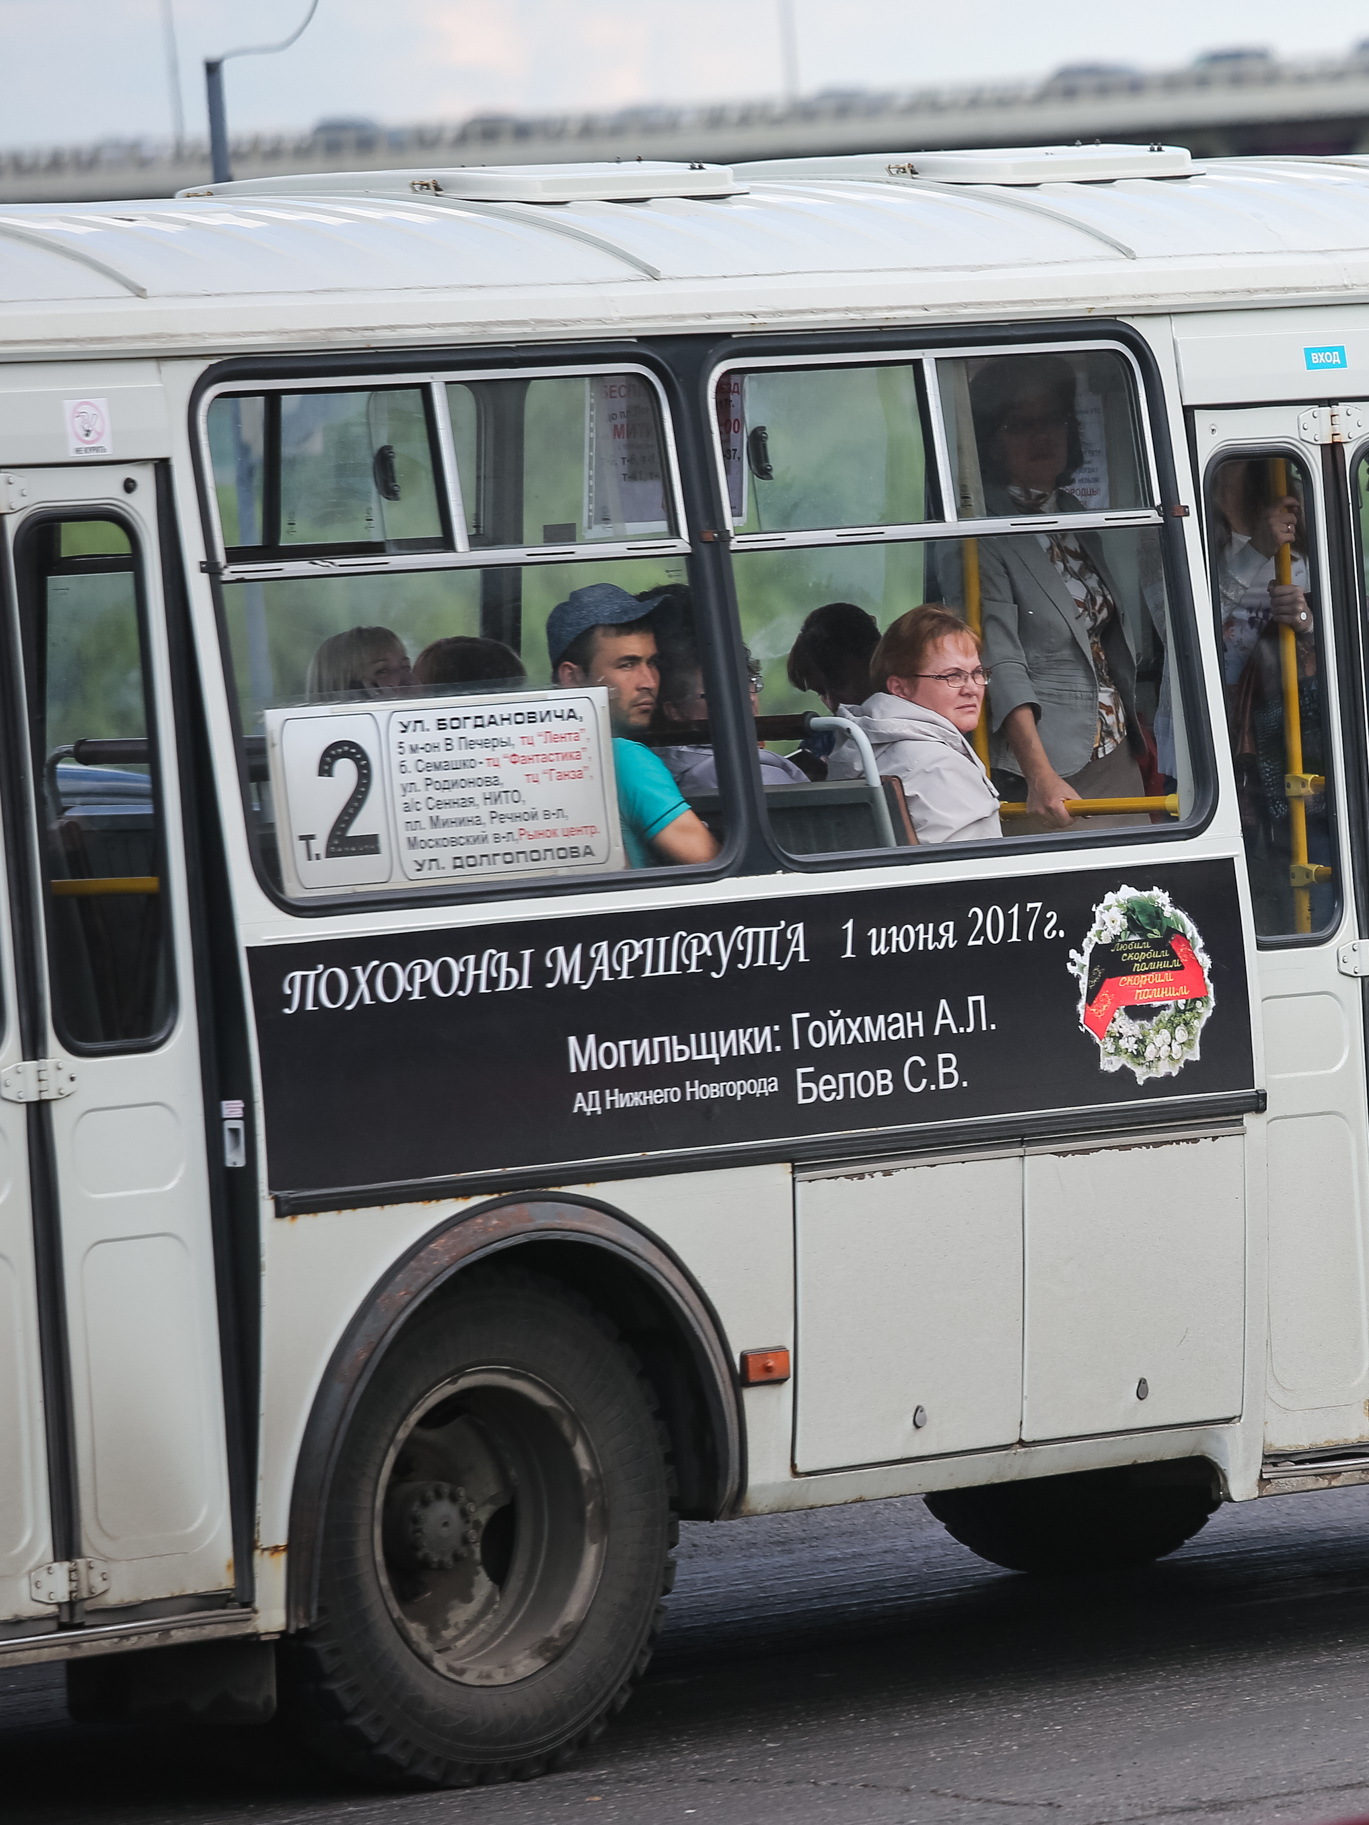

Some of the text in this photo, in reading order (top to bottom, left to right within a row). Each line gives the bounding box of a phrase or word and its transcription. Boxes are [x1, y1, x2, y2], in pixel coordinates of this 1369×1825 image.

[1310, 351, 1341, 365] ВХОД
[398, 708, 583, 734] УЛ. БОГДАНОВИЧА,
[398, 741, 406, 755] 5
[409, 742, 440, 754] м-он
[444, 737, 454, 752] В
[458, 736, 516, 752] Печеры,
[519, 735, 536, 747] тц
[400, 760, 412, 774] б.
[400, 782, 422, 798] ул.
[424, 775, 504, 792] Родионова,
[524, 773, 541, 785] тц
[317, 739, 382, 860] 2
[426, 796, 480, 811] Сенная,
[483, 789, 527, 807] НИТО,
[405, 807, 569, 832] пл. Минина, Речной в-л,
[406, 831, 490, 851] Московский
[561, 825, 601, 838] центр.
[413, 844, 596, 872] УЛ. ДОЛГОПОЛОВА
[282, 901, 1067, 1015] ПОХОРОНЫ МАРШРУТА 1 июня 2017г.
[1121, 948, 1171, 963] скорбим
[1132, 958, 1182, 972] помним
[1134, 985, 1191, 1000] помним
[567, 994, 998, 1074] Могильщики: Гойхман А.Л.
[796, 1052, 969, 1105] Белов С.В.
[572, 1075, 780, 1116] АД Нижнего Новгорода
